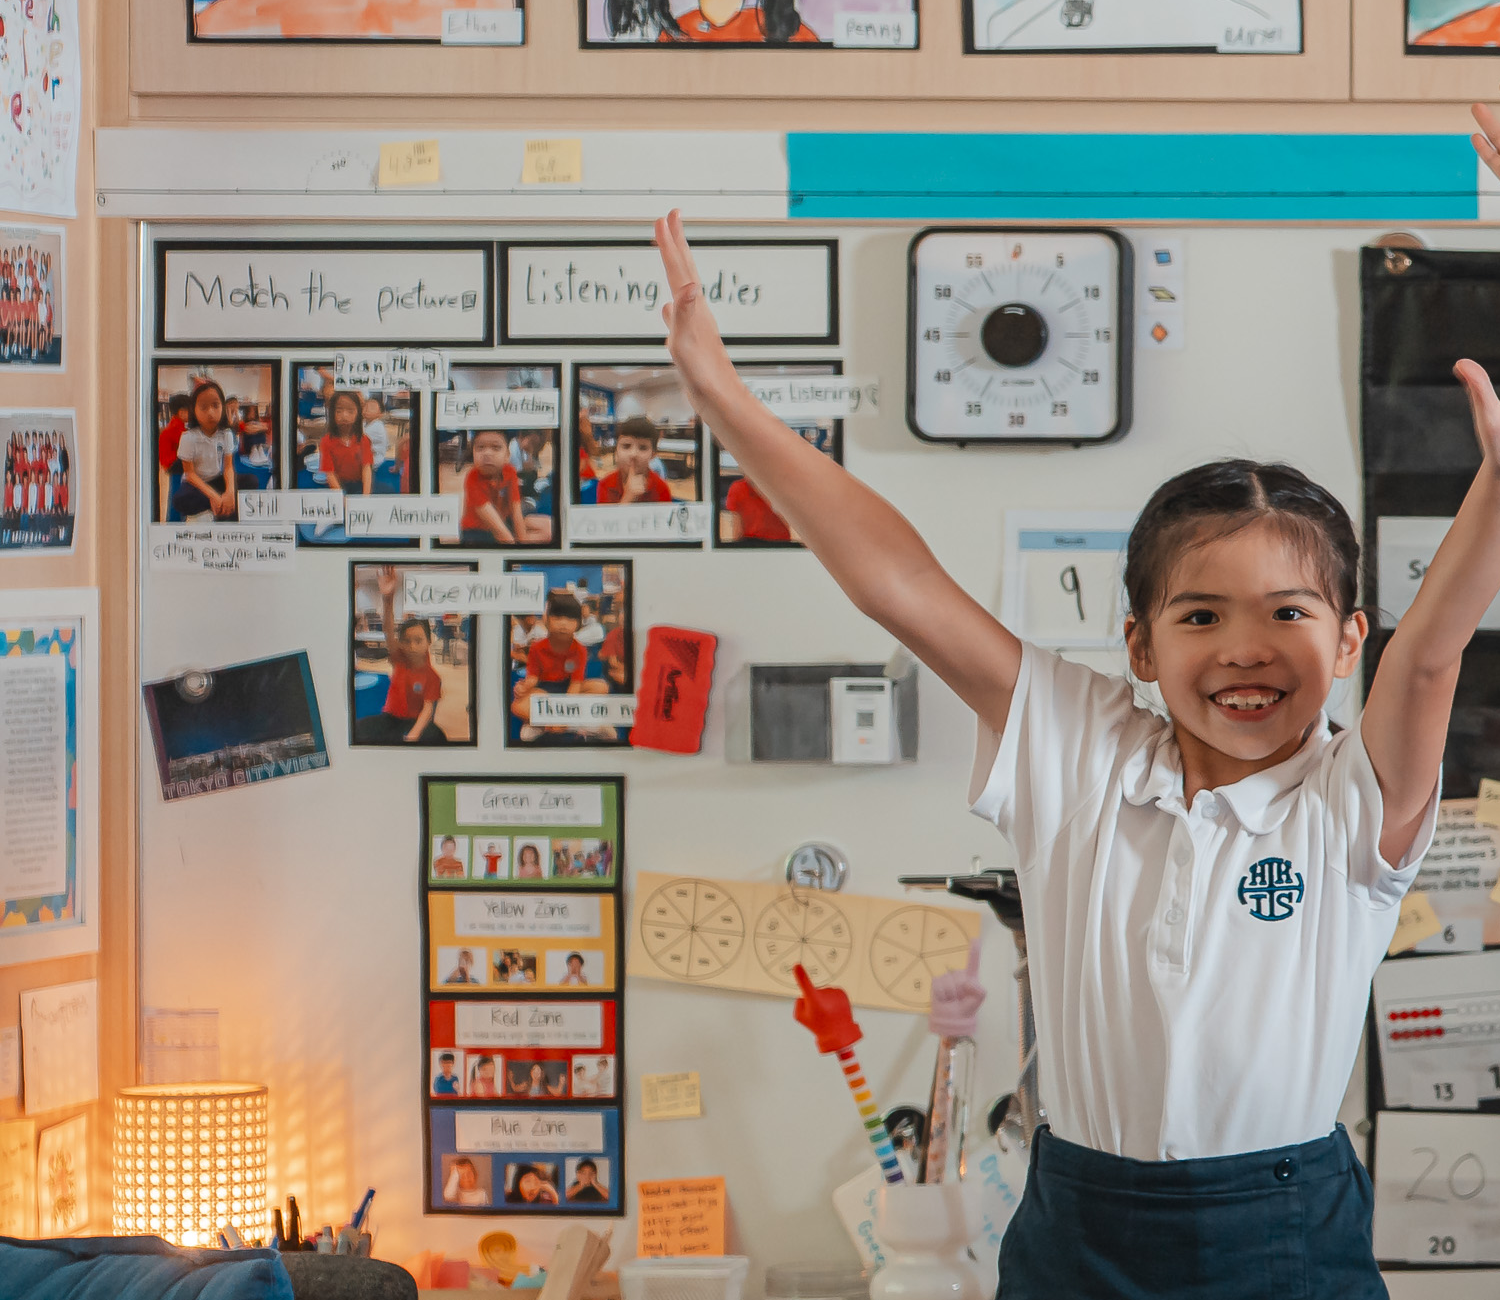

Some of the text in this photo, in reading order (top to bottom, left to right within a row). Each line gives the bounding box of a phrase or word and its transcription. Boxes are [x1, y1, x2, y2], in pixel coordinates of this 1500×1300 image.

[187, 266, 290, 312] Match
[303, 269, 351, 315] the
[482, 789, 574, 810] Green Zone
[483, 900, 569, 918] Yellow Zone
[491, 1007, 564, 1027] Red Zone
[1433, 1082, 1454, 1100] 13
[490, 1117, 567, 1138] Blue Zone
[1406, 1147, 1486, 1202] 20
[1429, 1236, 1456, 1254] 20
